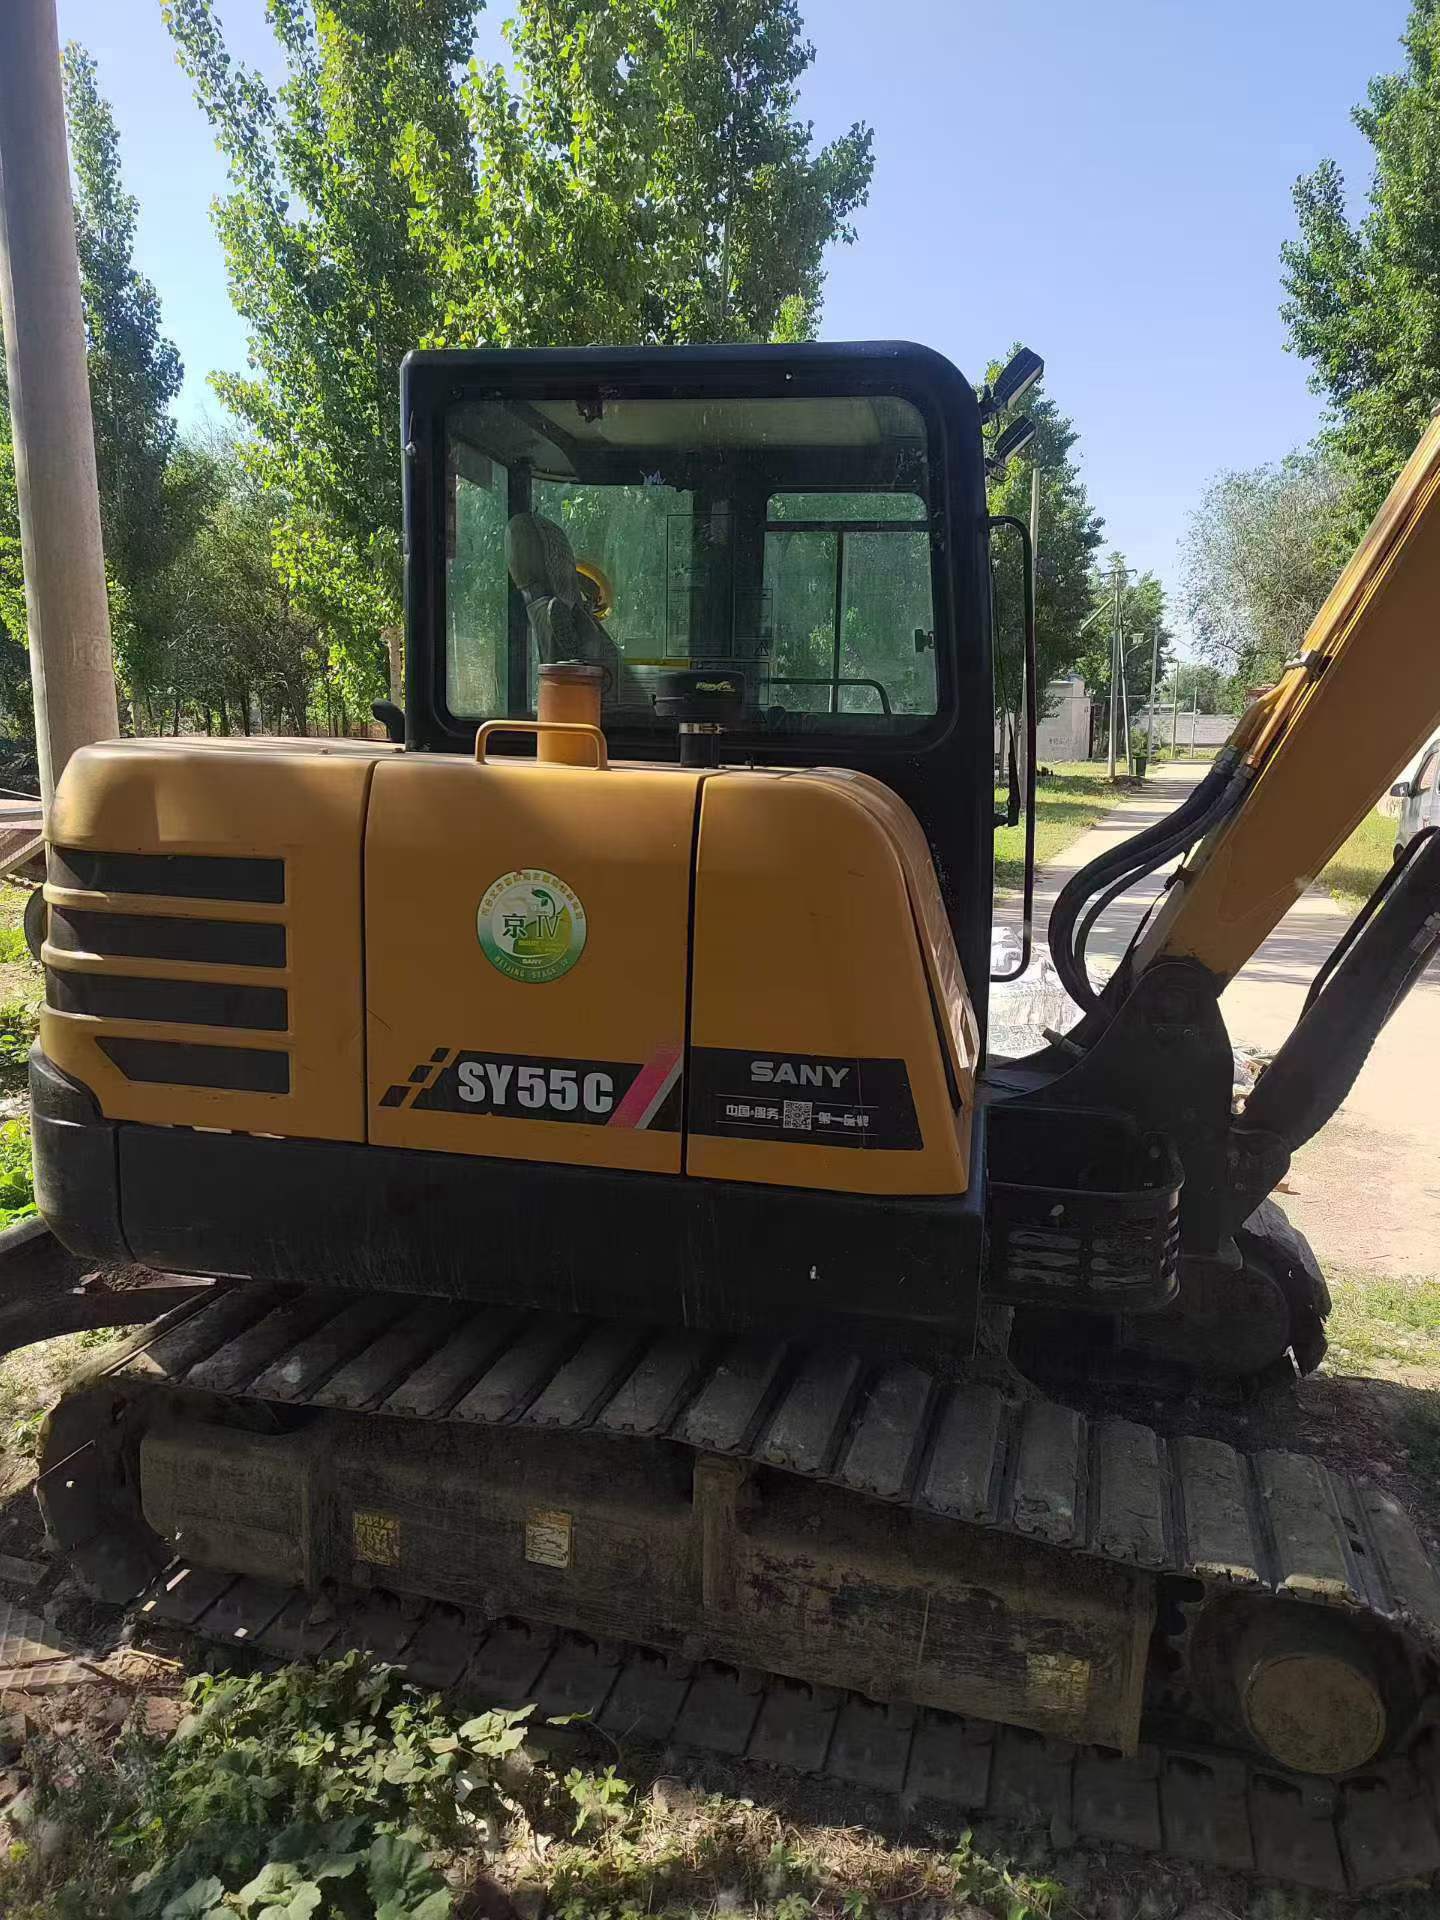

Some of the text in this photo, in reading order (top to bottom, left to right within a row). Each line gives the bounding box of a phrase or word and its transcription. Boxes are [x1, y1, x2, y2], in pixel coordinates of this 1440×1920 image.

[502, 913, 527, 938] 京
[458, 1061, 613, 1113] SY55C
[750, 1061, 850, 1088] SANY
